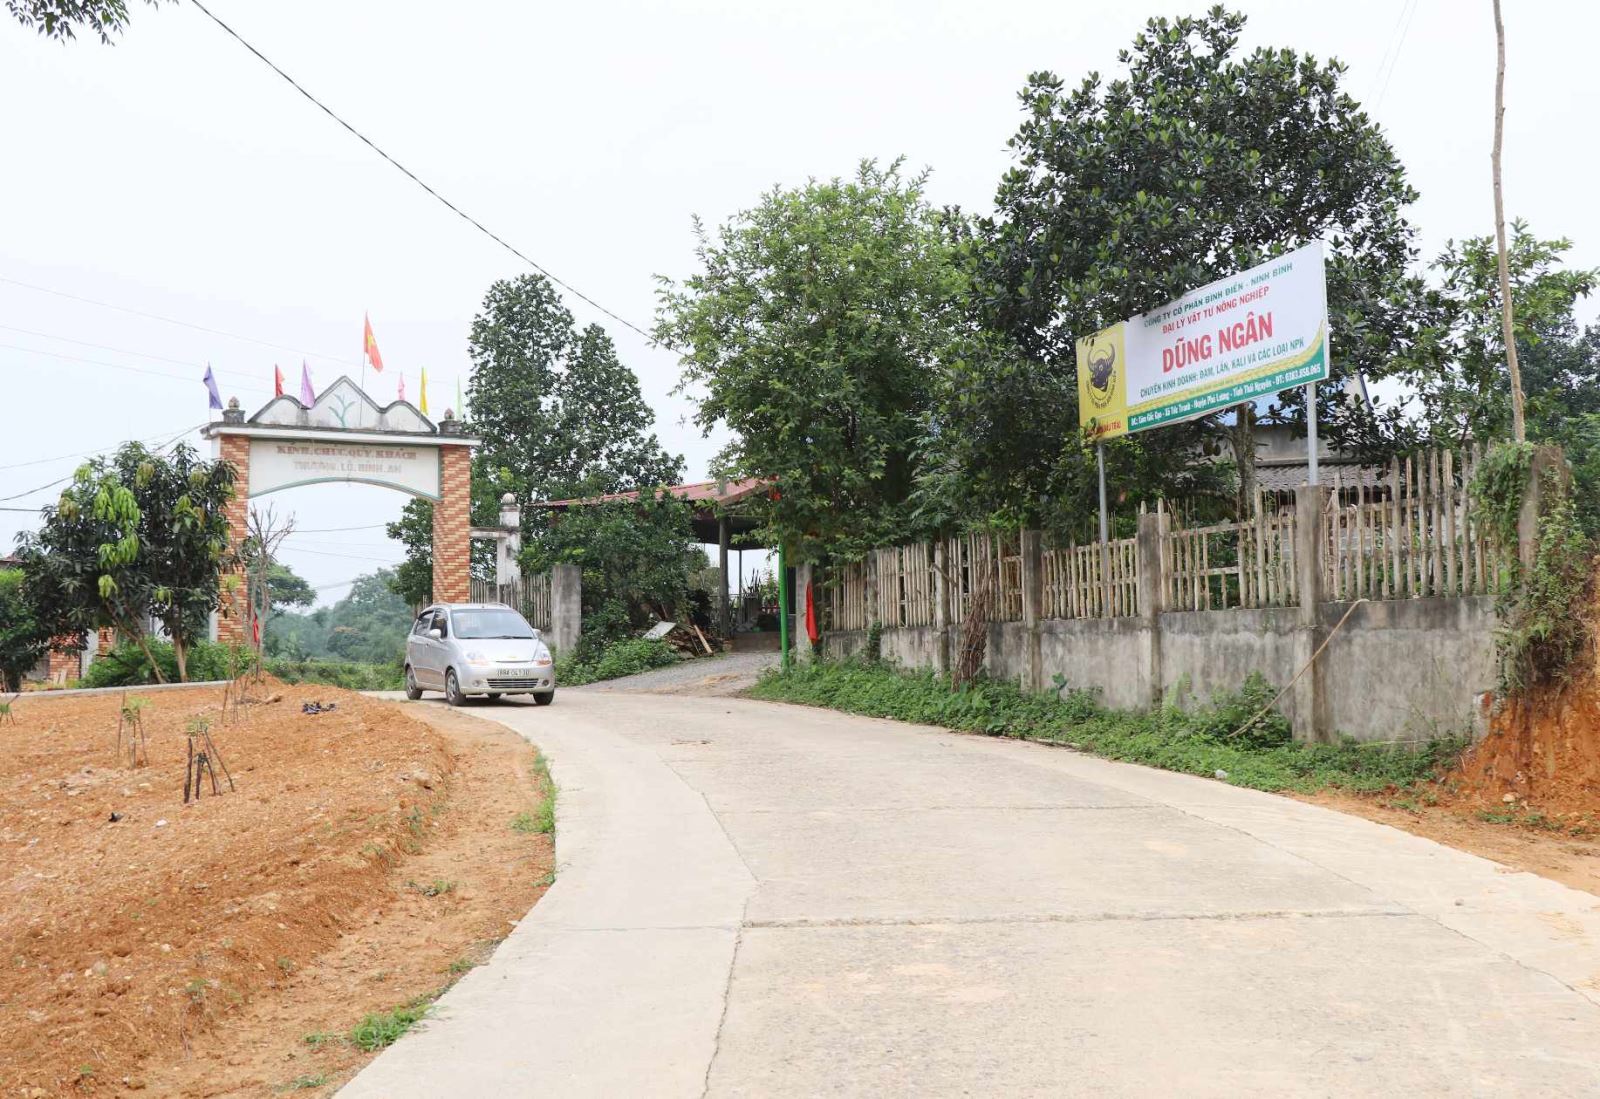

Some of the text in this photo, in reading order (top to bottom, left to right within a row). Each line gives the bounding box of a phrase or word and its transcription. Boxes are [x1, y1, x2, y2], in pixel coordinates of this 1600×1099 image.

[1144, 316, 1161, 329] CÔNG
[1163, 312, 1171, 321] TY
[1251, 272, 1270, 286] NINH
[1163, 323, 1175, 335] ĐẠI
[1177, 317, 1185, 329] LÝ
[1188, 312, 1201, 325] VẬT
[1217, 298, 1237, 314] NÔNG
[1240, 286, 1270, 305] NGHIỆP
[1141, 384, 1161, 398] CHUYÊN
[1163, 380, 1175, 391] KINH
[1232, 357, 1246, 369] KALI
[1274, 343, 1288, 356] LOẠI
[1291, 338, 1304, 350] NPK
[1163, 311, 1273, 373] DŨNG NGÂN
